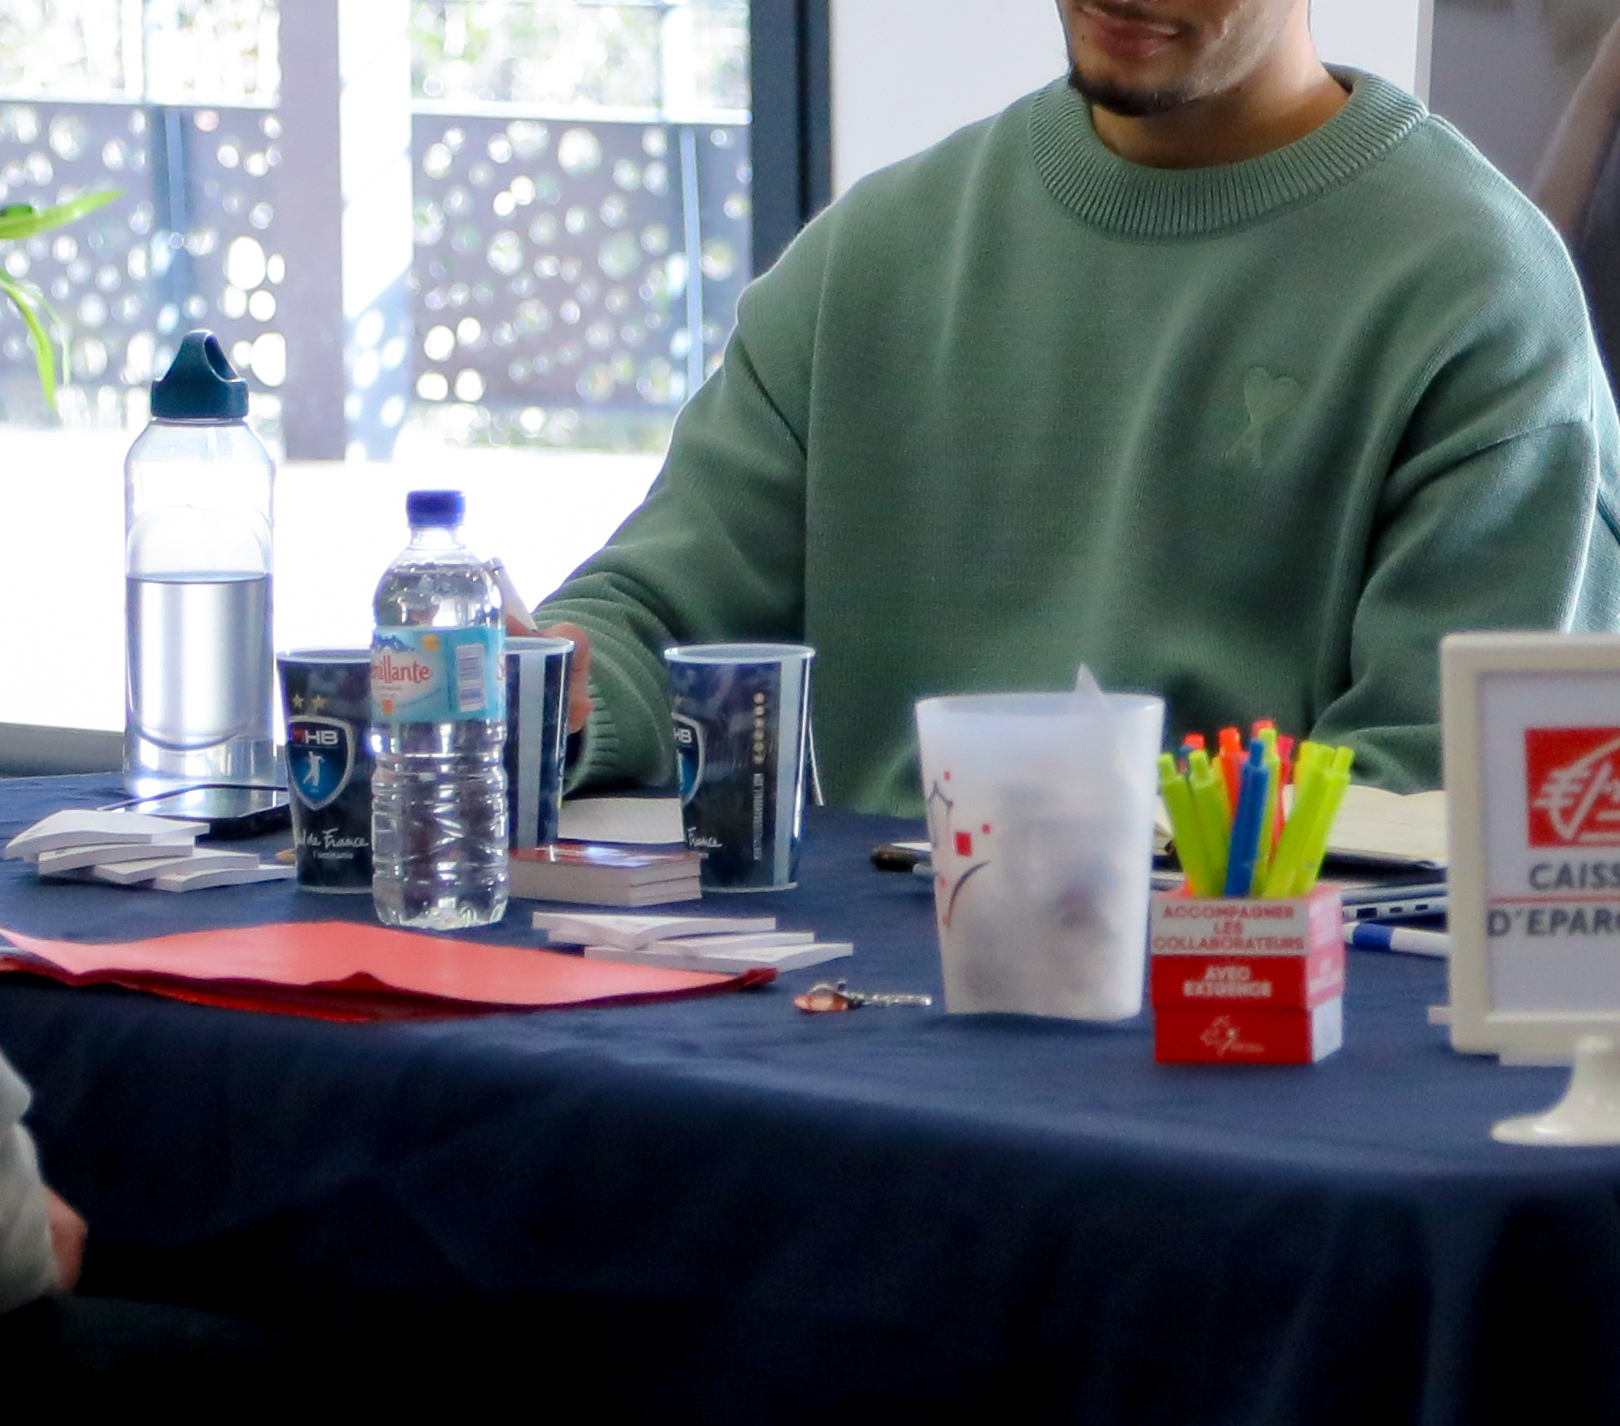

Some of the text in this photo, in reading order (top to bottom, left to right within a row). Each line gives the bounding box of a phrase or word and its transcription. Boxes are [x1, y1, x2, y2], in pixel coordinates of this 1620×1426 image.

[322, 827, 369, 849] France
[1163, 905, 1295, 919] ACCOMPAGNER
[1152, 936, 1306, 950] COLLABORATEURS
[1204, 965, 1252, 981] AVEC
